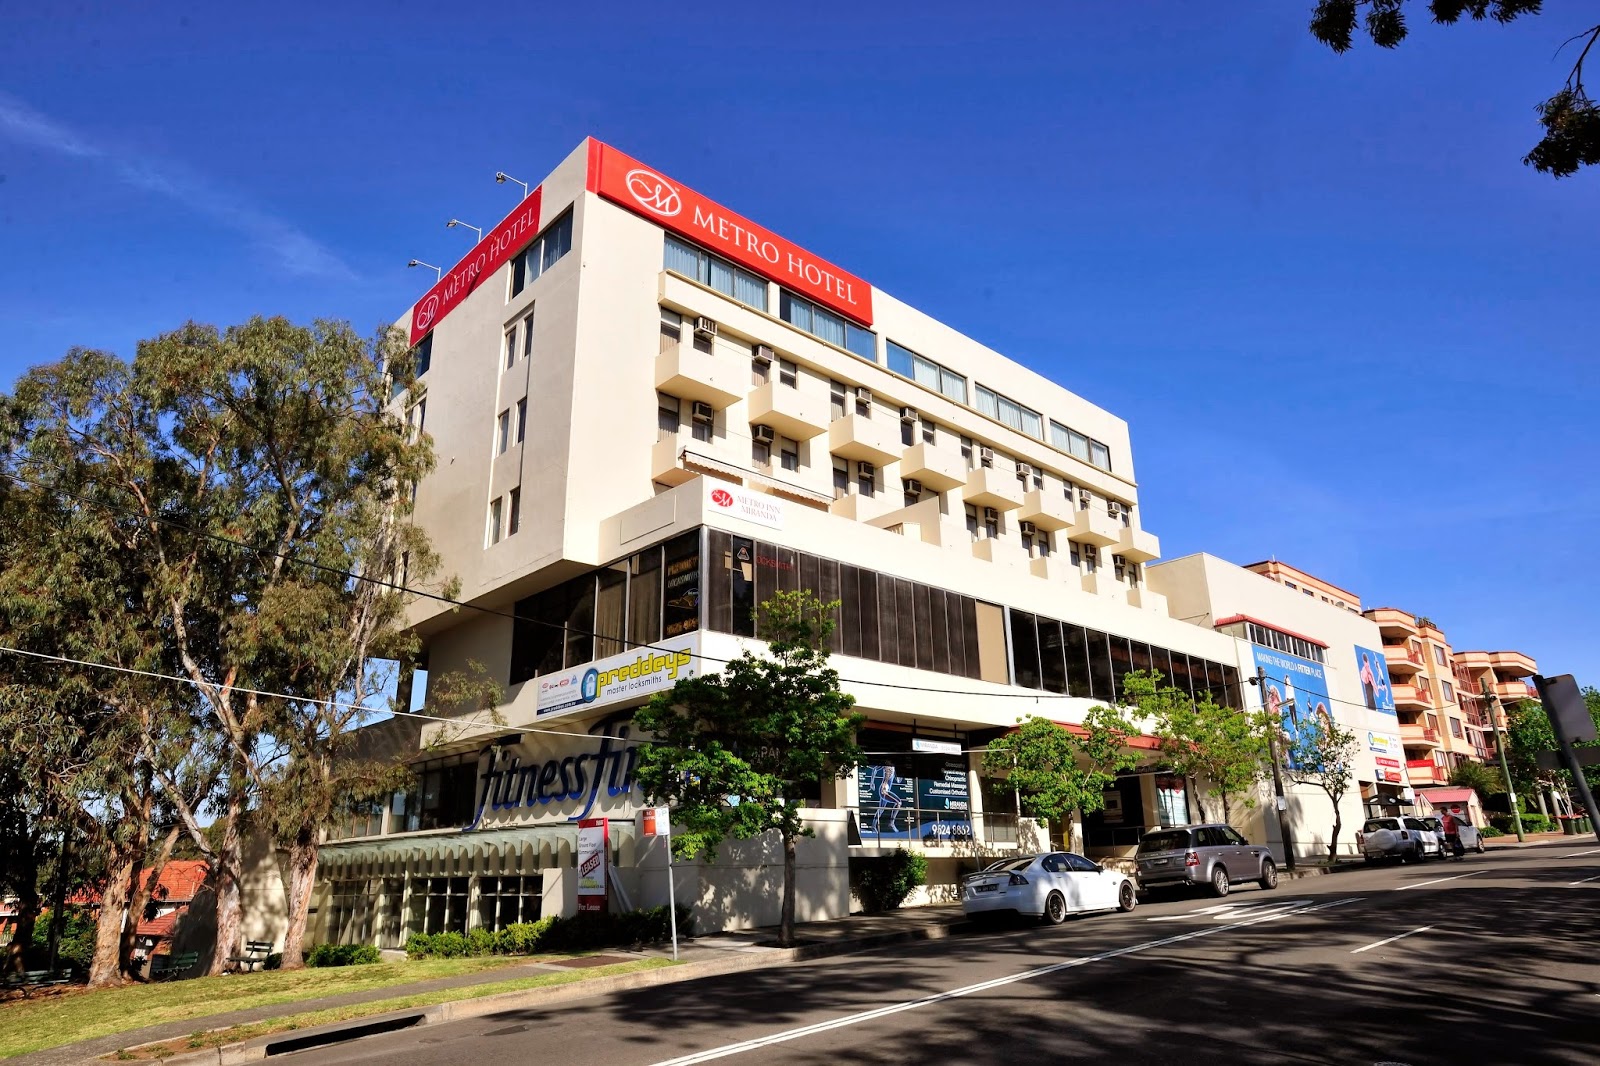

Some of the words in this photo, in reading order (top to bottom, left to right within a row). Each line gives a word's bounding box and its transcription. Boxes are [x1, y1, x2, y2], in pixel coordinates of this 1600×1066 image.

[442, 253, 486, 306] METRO
[489, 208, 535, 262] HOTEL
[693, 205, 780, 264] METRO
[787, 252, 857, 305] HOTEL
[737, 495, 765, 510] METRO
[766, 503, 781, 514] INN
[741, 505, 777, 522] MIRANDA
[597, 648, 692, 698] preddeys
[606, 683, 627, 696] master
[628, 675, 662, 691] locksmiths
[931, 824, 951, 836] 9524
[581, 855, 599, 876] LEASED
[578, 903, 586, 911] For
[586, 903, 600, 911] Lease
